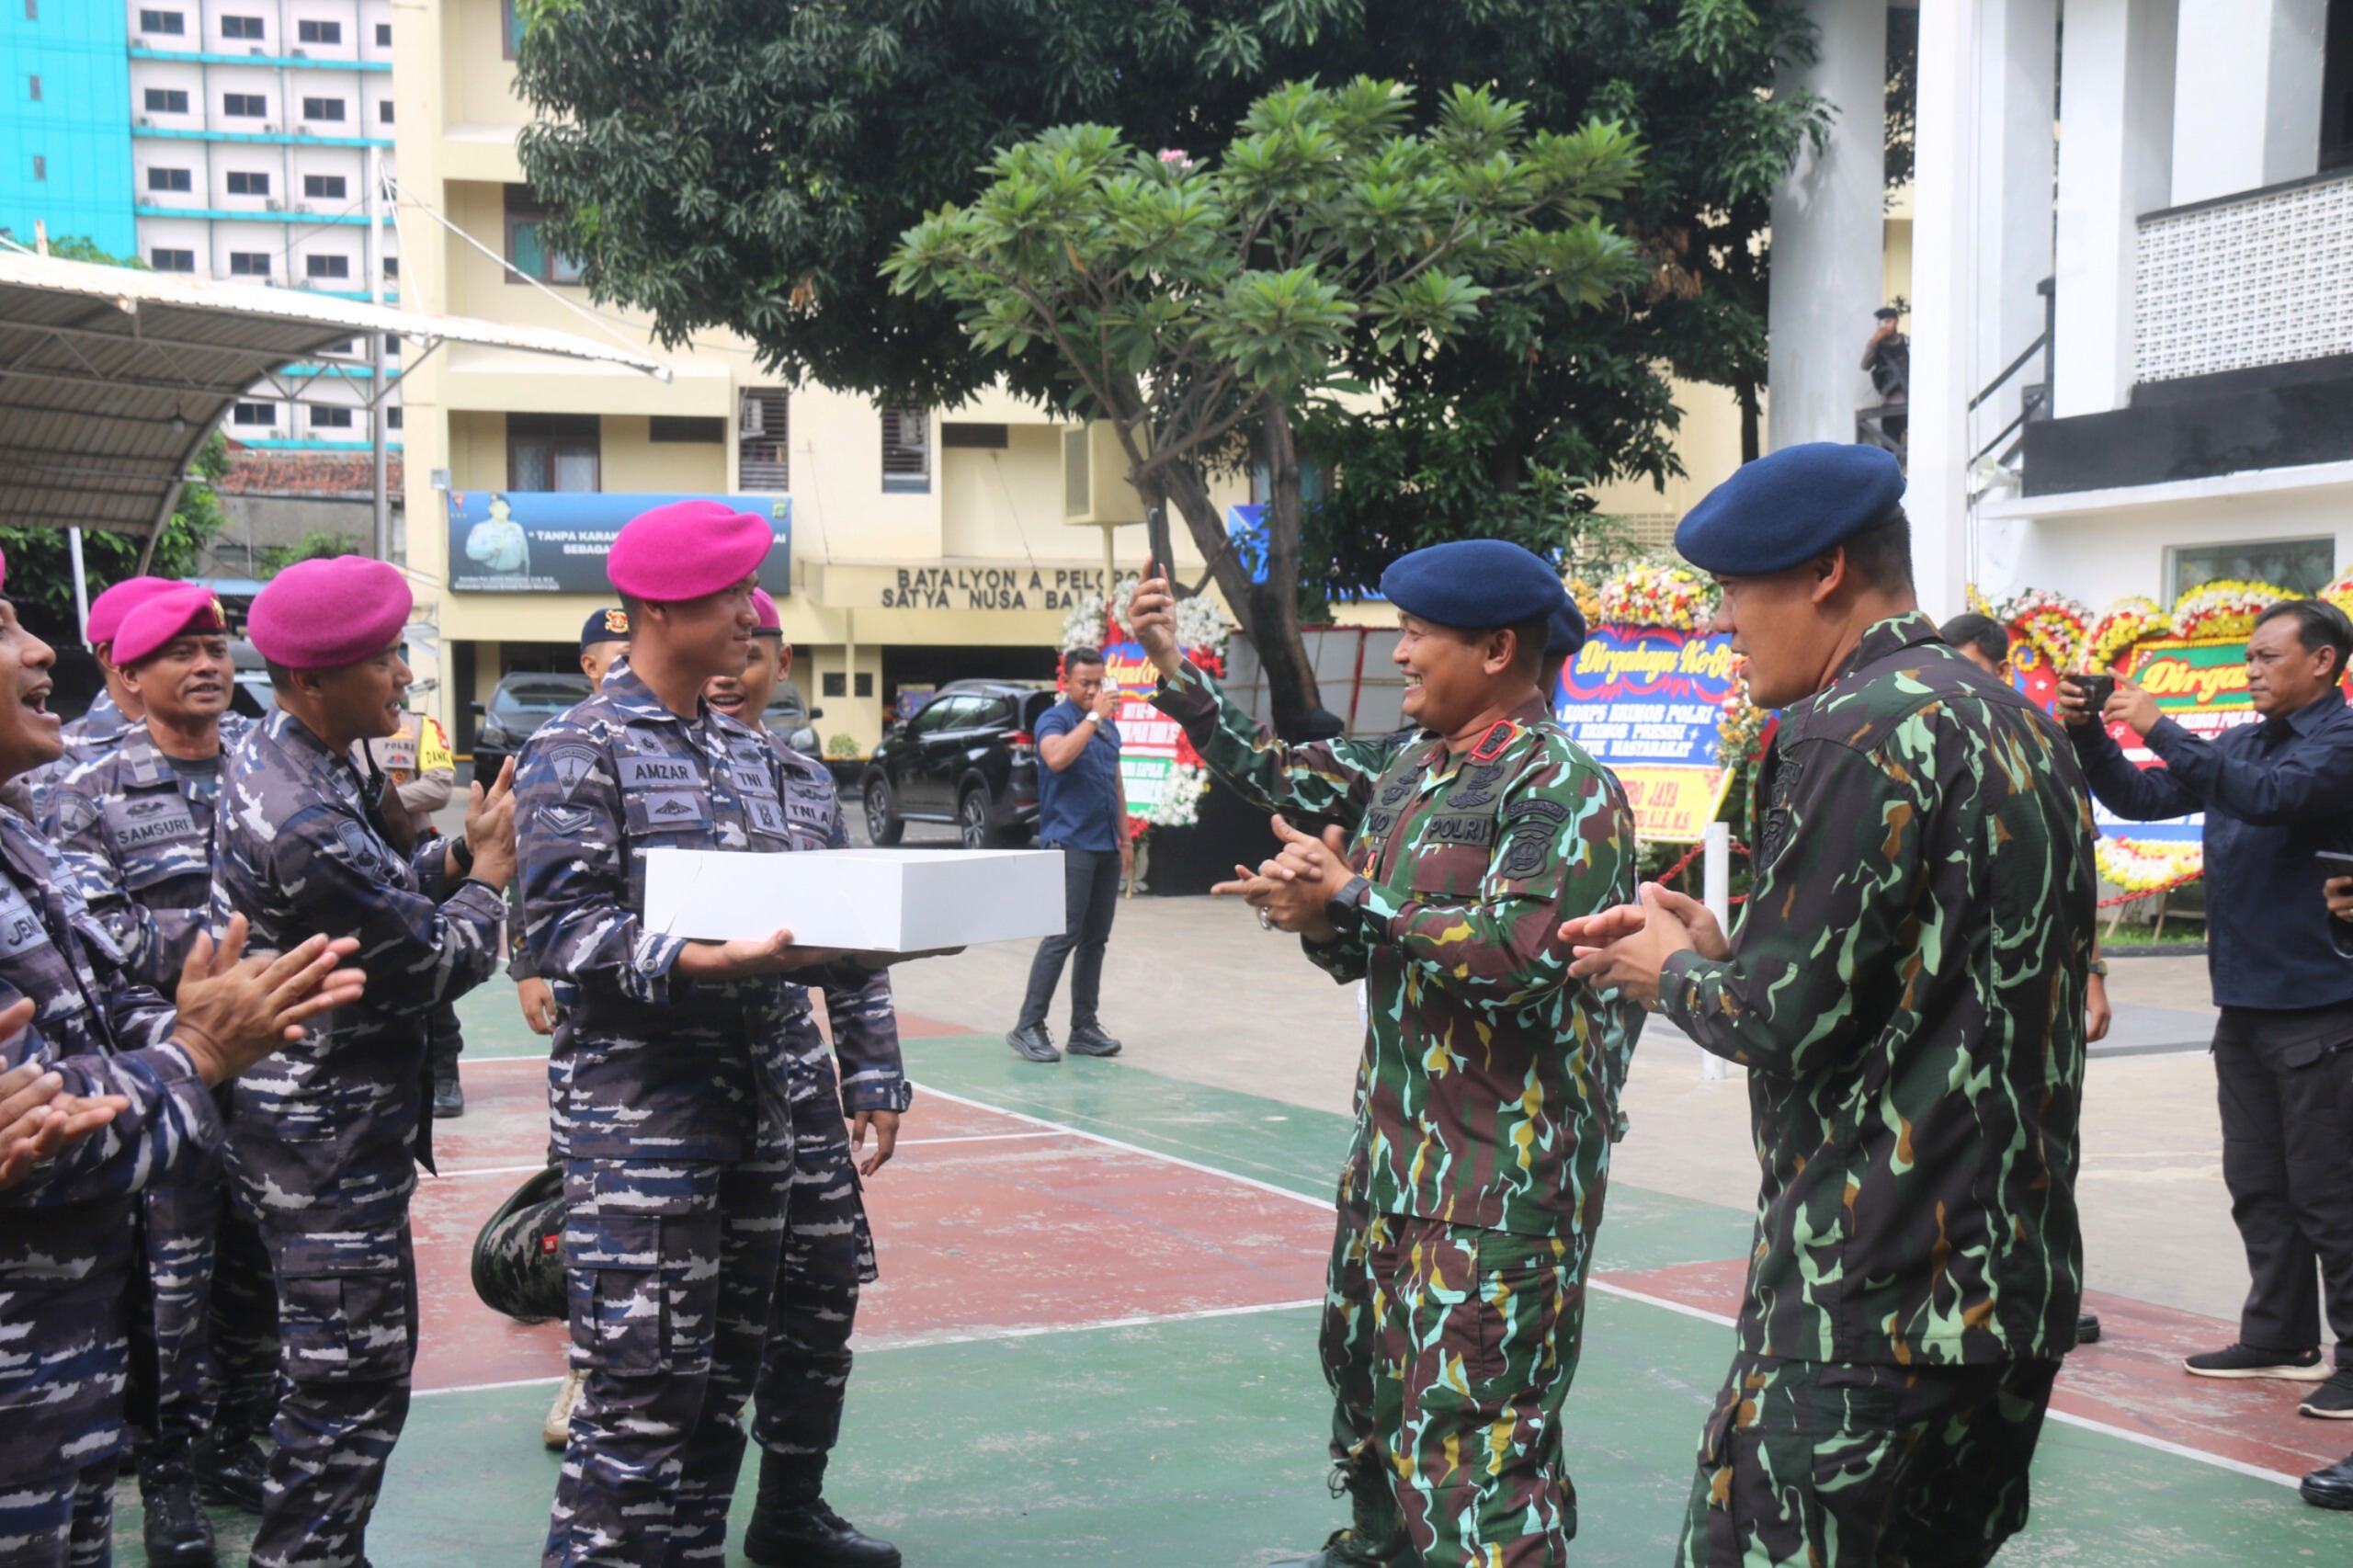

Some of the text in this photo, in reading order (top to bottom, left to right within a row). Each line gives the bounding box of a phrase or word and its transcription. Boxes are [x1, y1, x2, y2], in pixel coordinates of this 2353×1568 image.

[897, 569, 1016, 589] BATALYON
[1029, 570, 1043, 589] A
[881, 589, 950, 608] SATYA
[970, 589, 1027, 608] NUSA
[1563, 704, 1715, 724] KORPS BRIMOB POLRI
[1578, 723, 1630, 740] BRIMOB
[1609, 741, 1694, 757] MASYARAKAT
[635, 764, 689, 779] AMZAR
[737, 772, 763, 788] TNI
[789, 804, 816, 822] TNI
[118, 819, 188, 844] SAMSURI
[1427, 818, 1487, 841] POLRI
